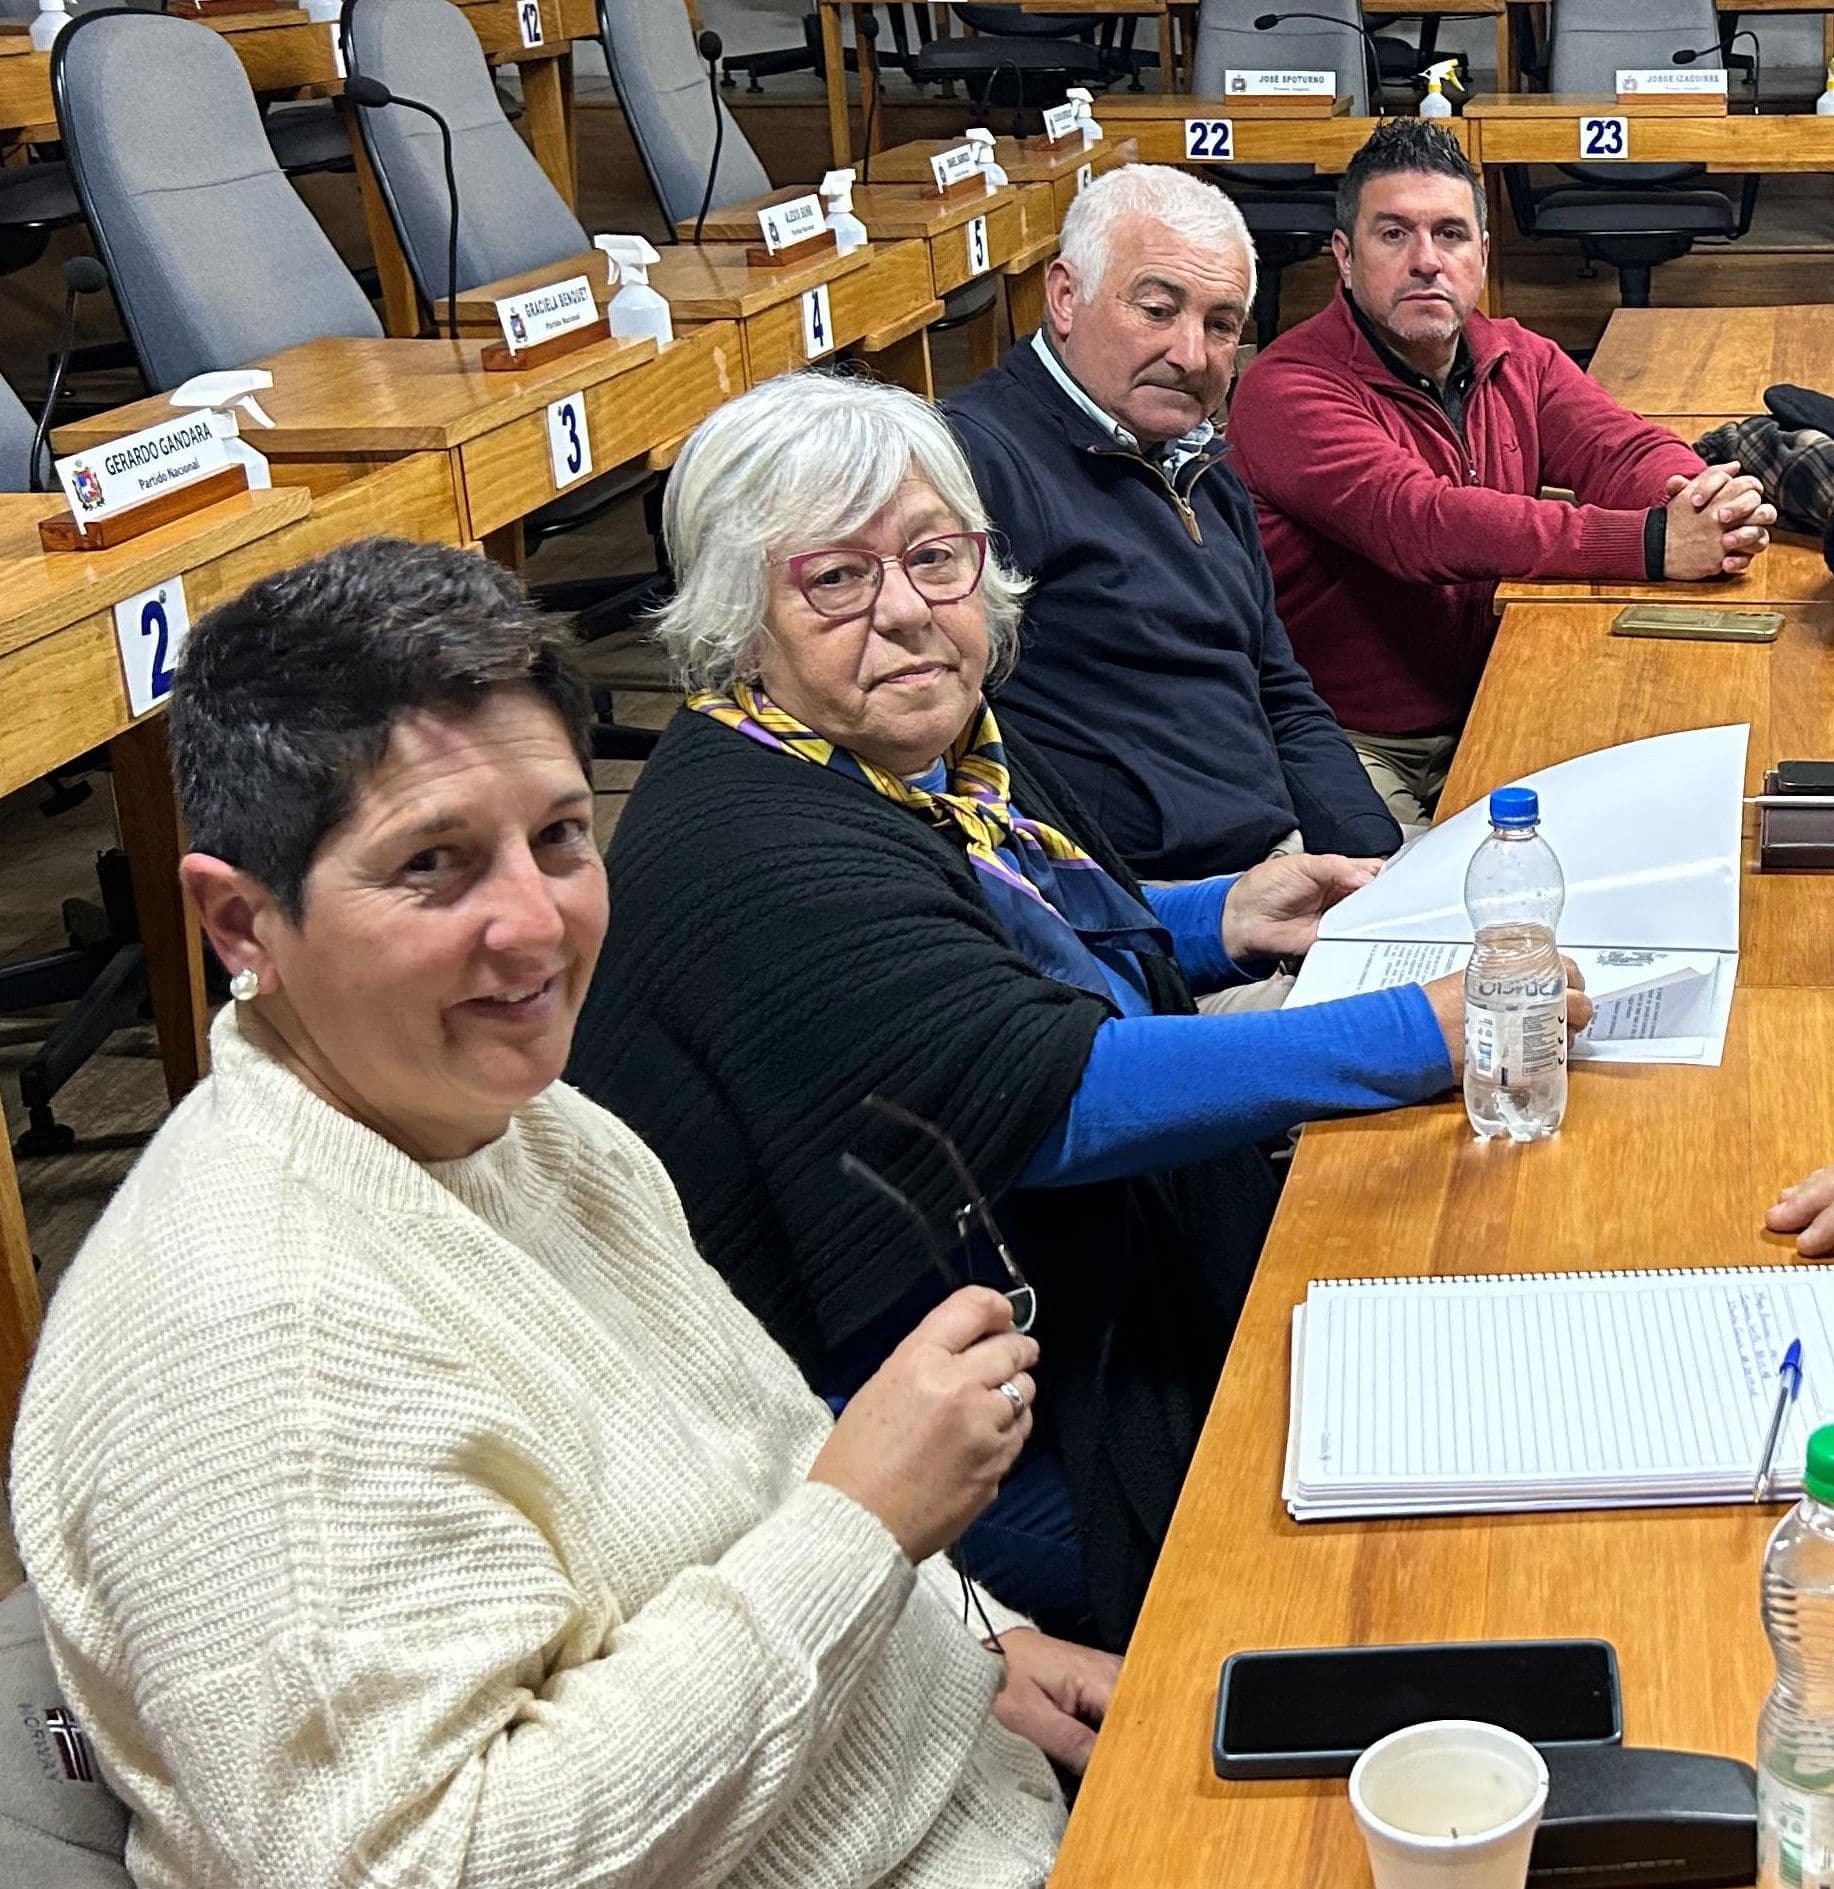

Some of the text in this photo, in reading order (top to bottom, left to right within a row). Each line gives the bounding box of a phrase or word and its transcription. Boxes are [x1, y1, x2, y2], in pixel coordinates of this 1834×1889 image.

[522, 4, 541, 43] 12
[1190, 121, 1230, 156] 22
[1586, 120, 1623, 154] 23
[974, 219, 984, 268] 5
[524, 295, 559, 318] GRACIELA
[811, 290, 825, 348] 4
[105, 421, 213, 476] GERARDO GANDARA
[562, 403, 582, 474] 3
[138, 457, 201, 491] Partido Nacional
[140, 600, 176, 700] 2
